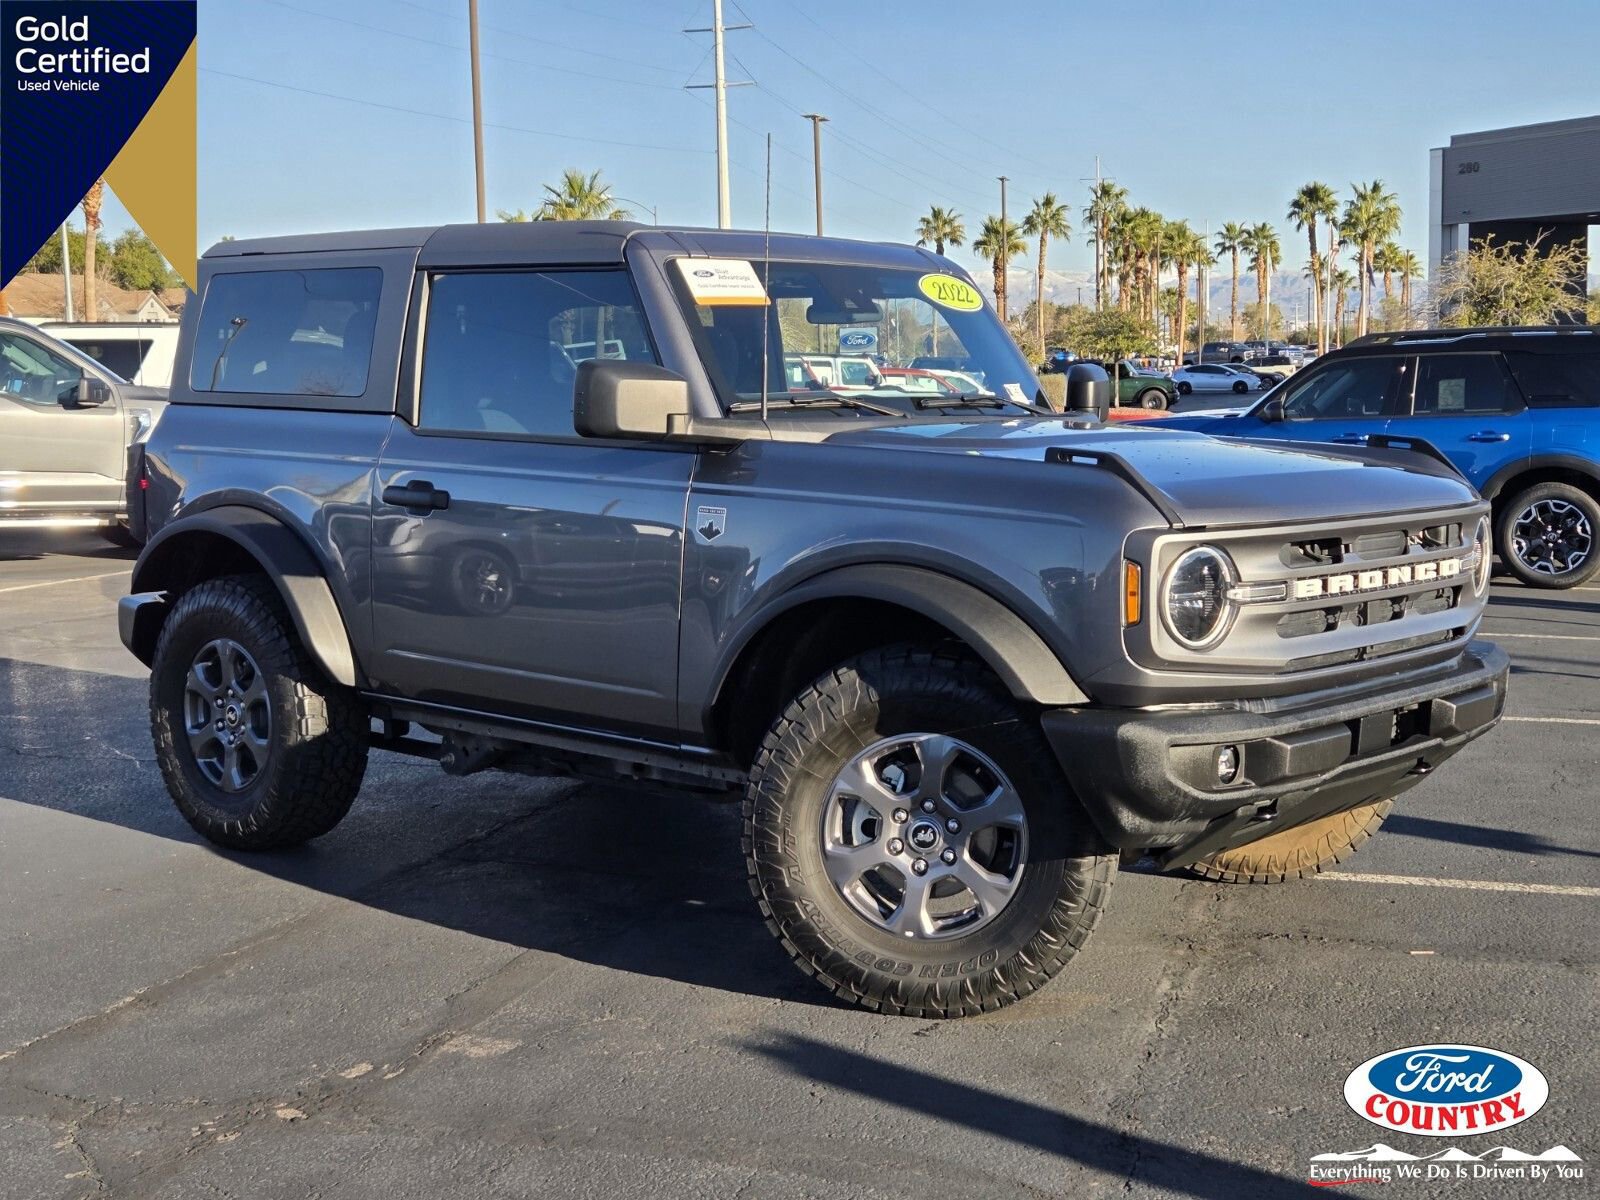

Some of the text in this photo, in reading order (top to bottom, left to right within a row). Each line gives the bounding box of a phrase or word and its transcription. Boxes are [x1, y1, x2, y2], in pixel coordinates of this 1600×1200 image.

[931, 281, 975, 303] 2022
[846, 335, 869, 345] Ford
[1294, 558, 1461, 599] BRONCO
